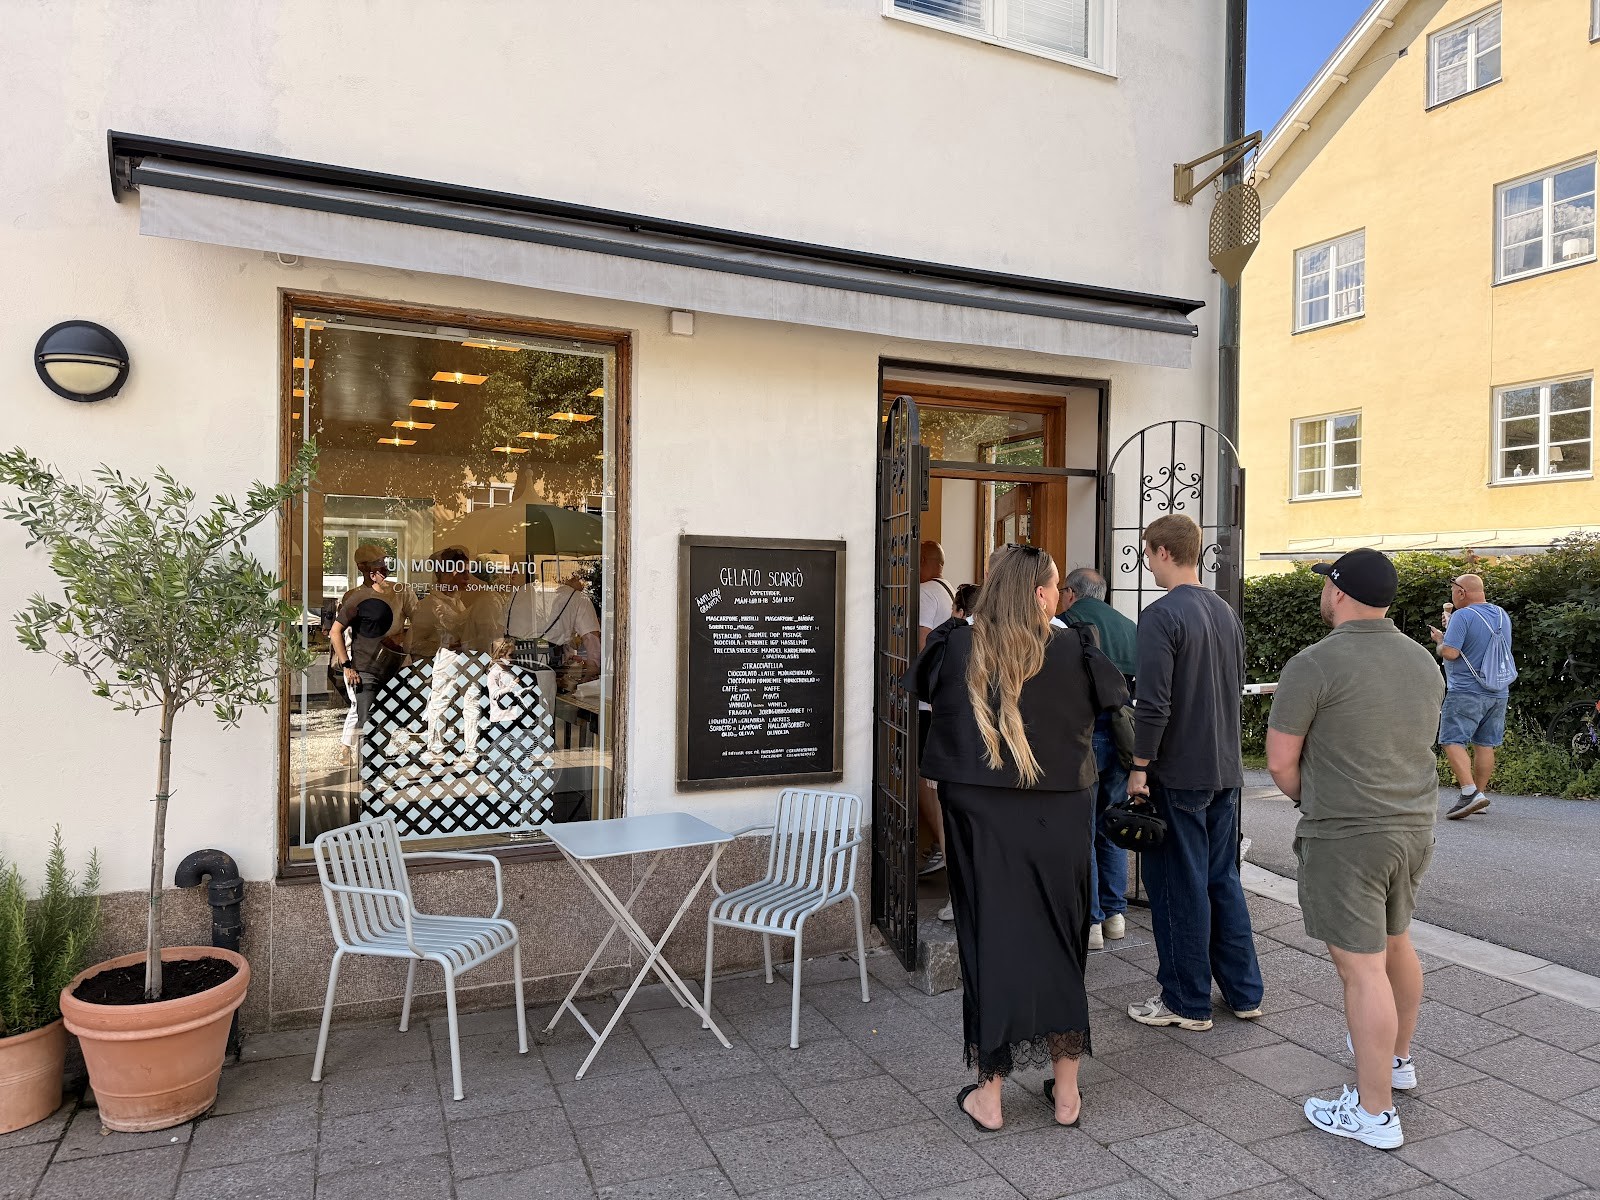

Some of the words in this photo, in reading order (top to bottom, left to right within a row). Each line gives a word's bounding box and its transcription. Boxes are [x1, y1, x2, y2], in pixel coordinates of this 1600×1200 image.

[387, 558, 407, 572] UN
[412, 560, 465, 573] MONDO
[469, 560, 482, 573] DI
[485, 560, 536, 575] GELATO
[720, 567, 760, 586] GELATO
